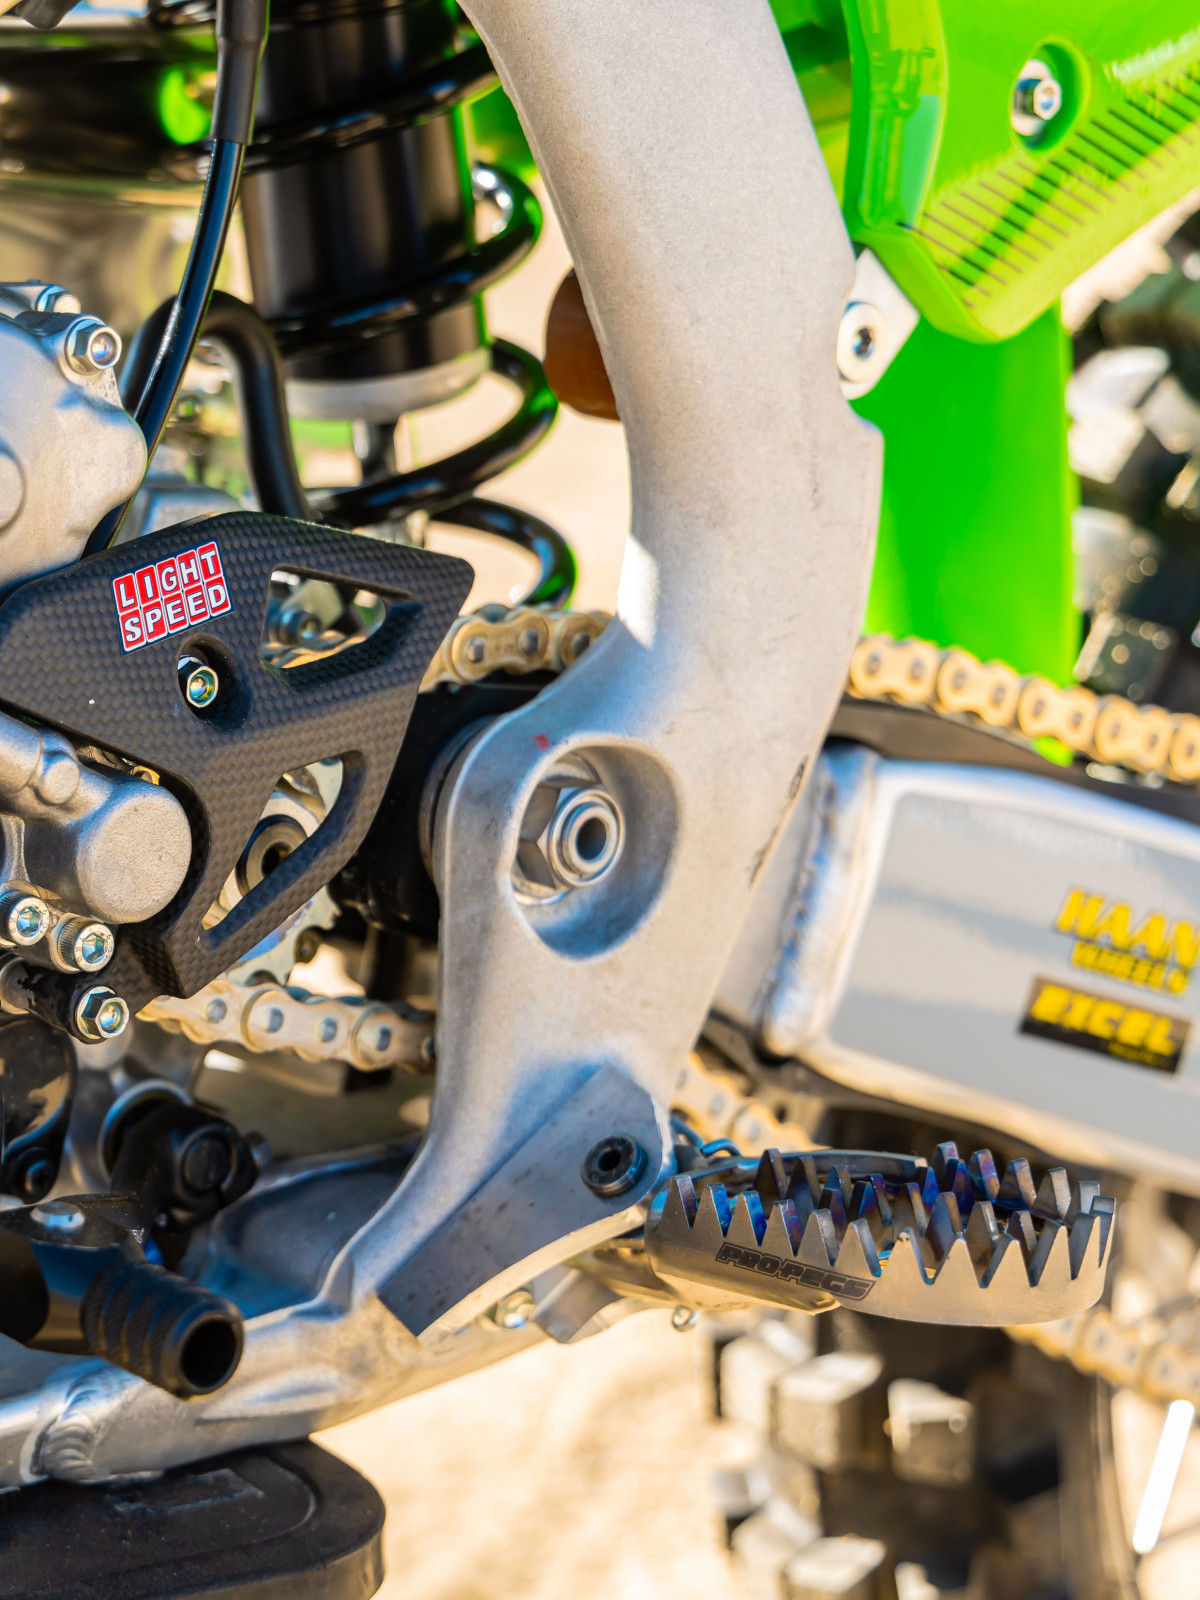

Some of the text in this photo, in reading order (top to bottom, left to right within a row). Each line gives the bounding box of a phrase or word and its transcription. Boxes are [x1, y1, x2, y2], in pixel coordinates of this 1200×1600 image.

[118, 549, 216, 609] LIGHT
[123, 583, 228, 643] SPEED
[1031, 984, 1176, 1057] EXCEL
